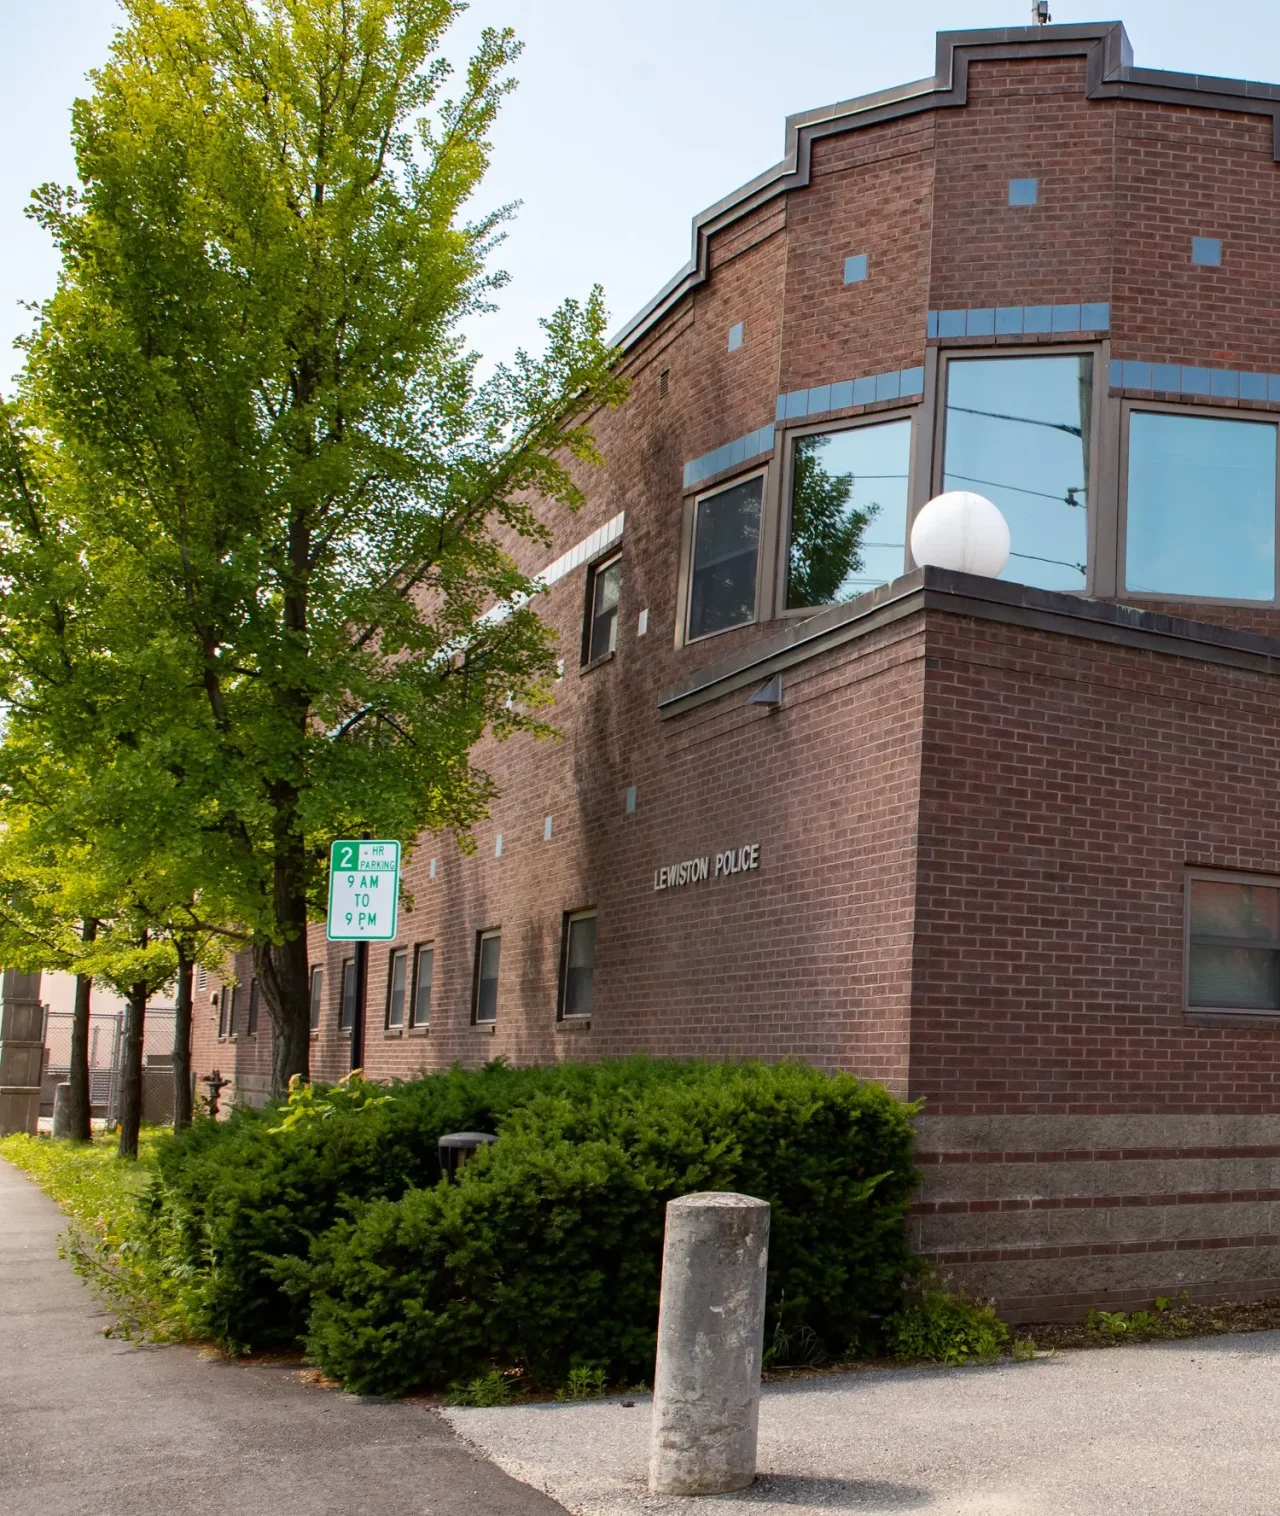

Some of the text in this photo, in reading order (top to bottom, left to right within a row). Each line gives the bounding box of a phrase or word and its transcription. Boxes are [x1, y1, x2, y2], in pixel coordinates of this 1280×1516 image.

[340, 847, 353, 867] 2
[372, 846, 384, 856] HR
[360, 861, 395, 870] PARKING
[654, 844, 759, 890] LEWISTON POLICE
[347, 875, 379, 888] 9 AM
[354, 893, 370, 907] TO
[345, 912, 377, 925] 9 PM
